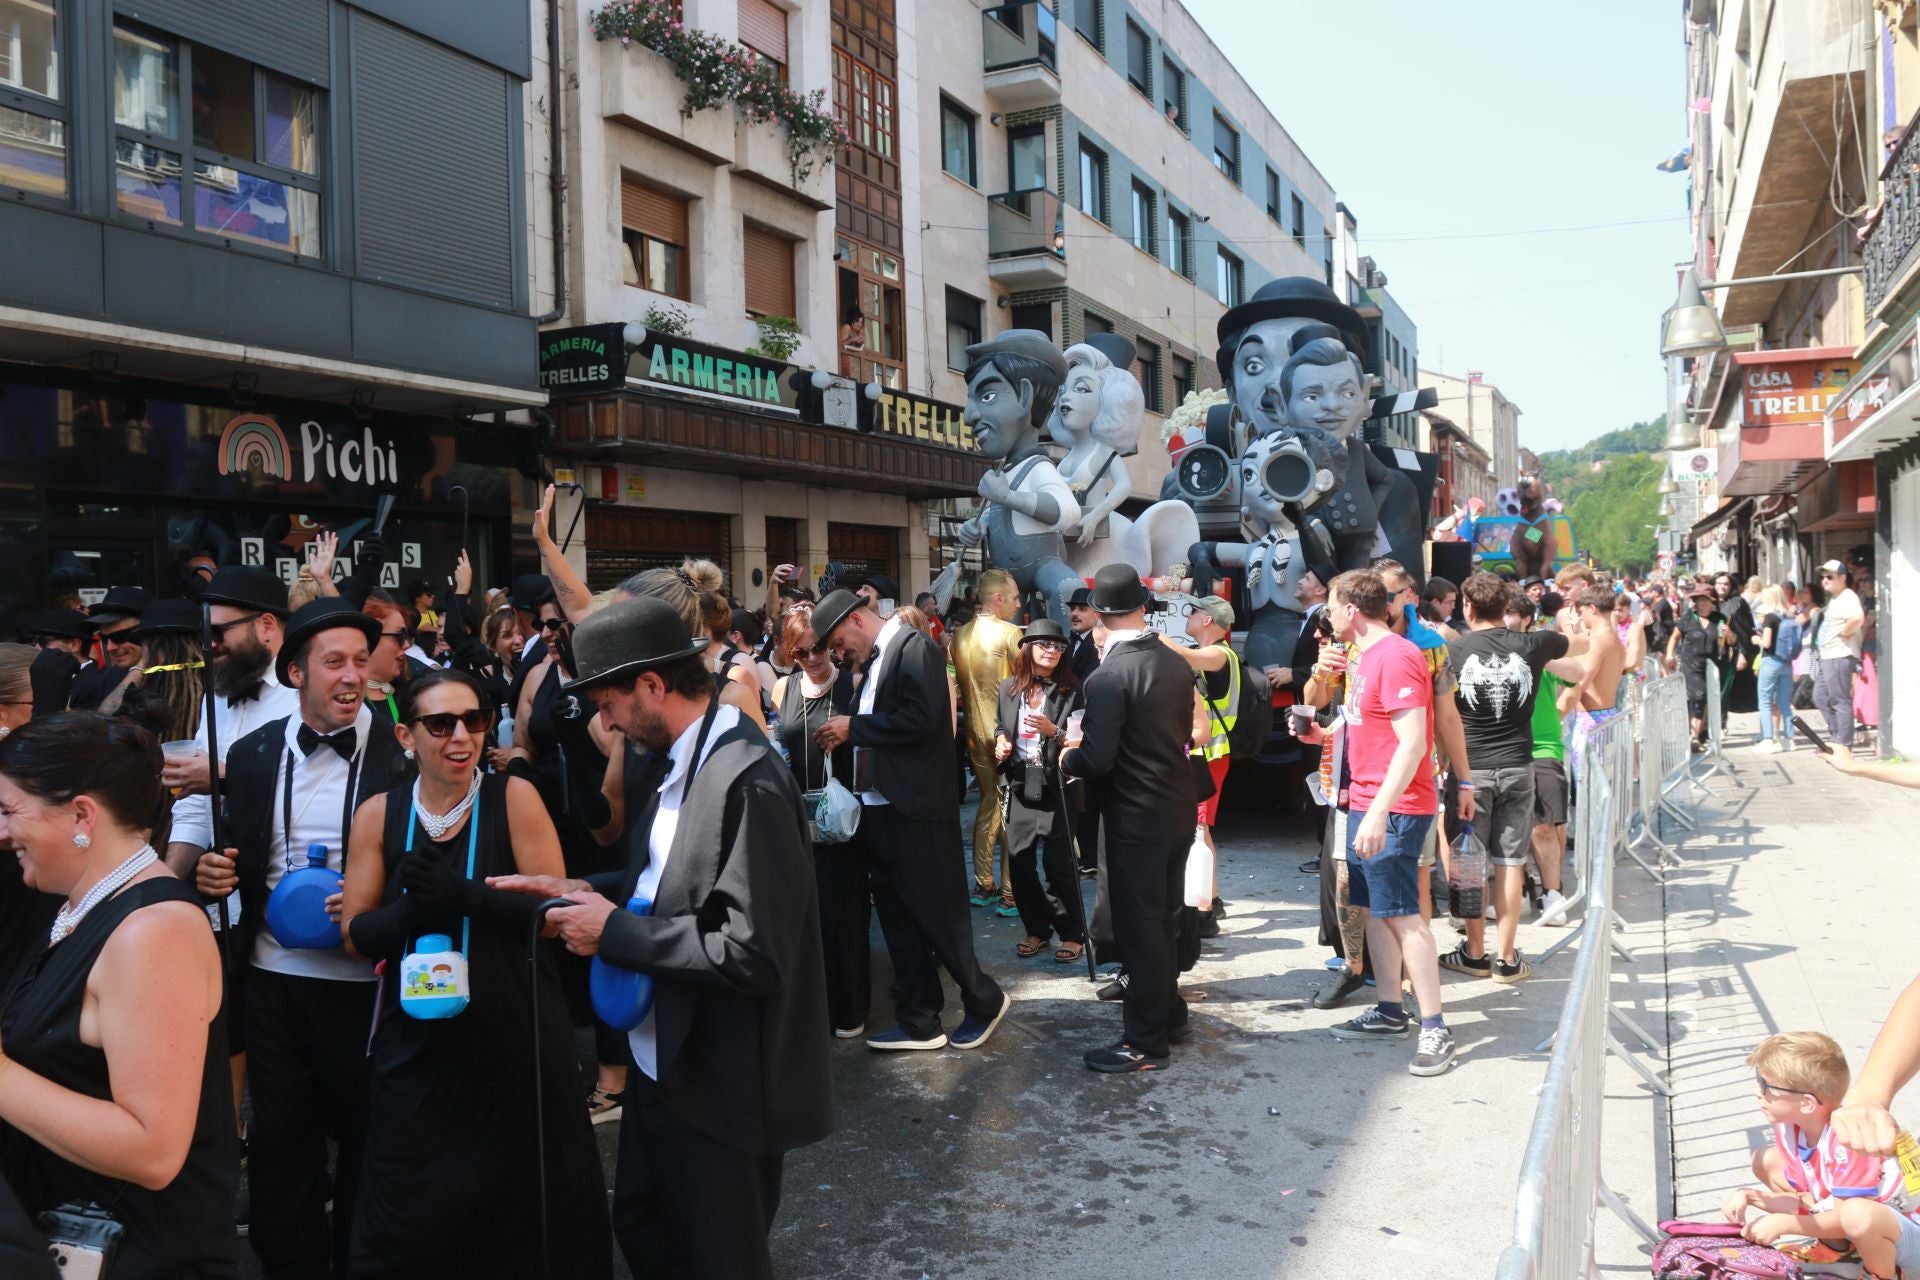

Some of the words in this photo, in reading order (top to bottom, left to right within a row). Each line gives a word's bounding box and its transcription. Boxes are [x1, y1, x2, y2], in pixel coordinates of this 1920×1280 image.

[540, 337, 606, 363] ARMERIA
[539, 364, 609, 386] TRELLES
[649, 343, 781, 404] ARMERIA
[1749, 371, 1793, 388] CASA
[878, 393, 982, 452] TRELLE
[300, 420, 398, 486] Pichi
[244, 541, 416, 586] REAAS
